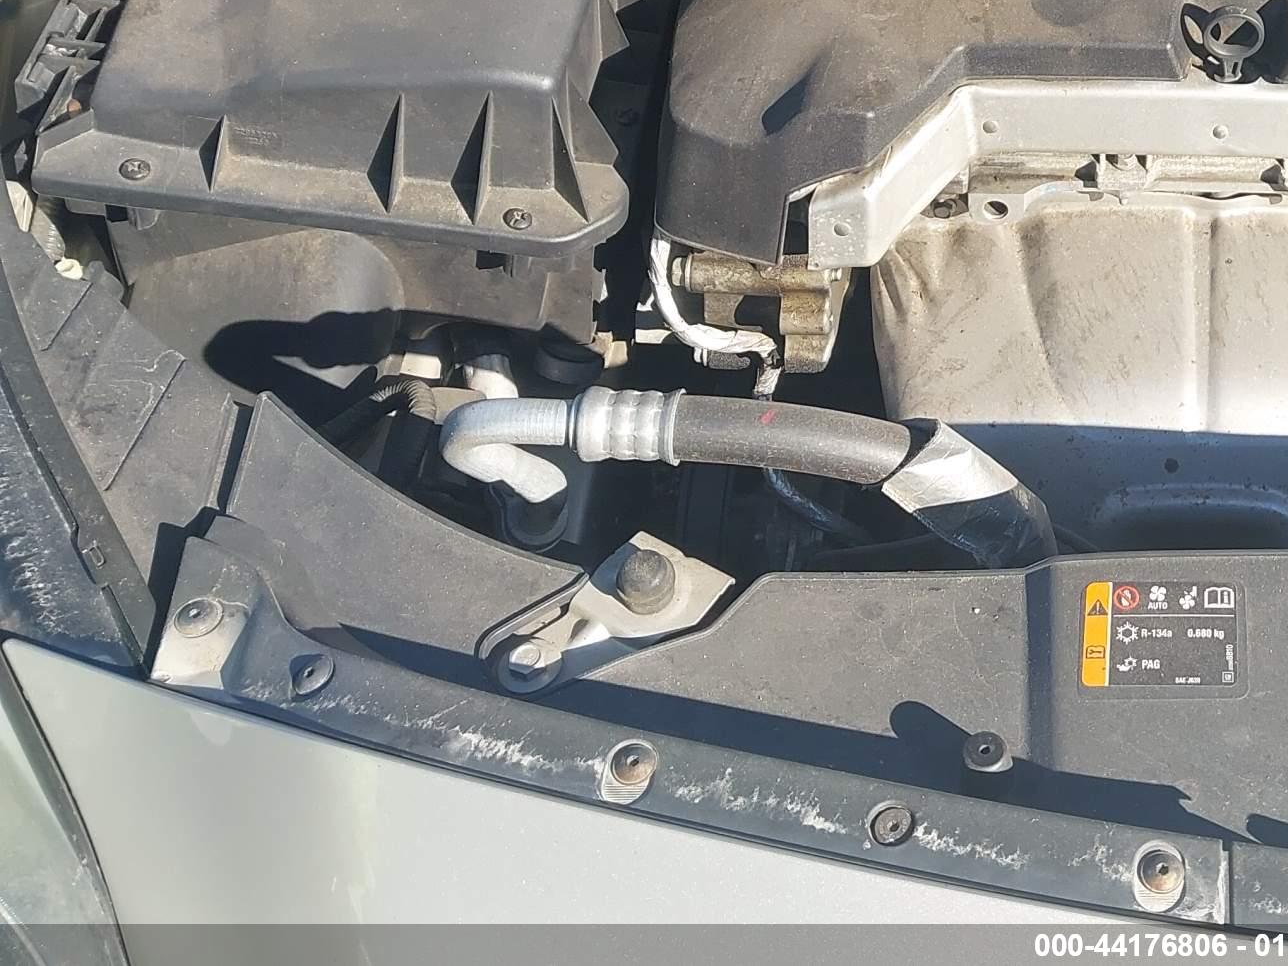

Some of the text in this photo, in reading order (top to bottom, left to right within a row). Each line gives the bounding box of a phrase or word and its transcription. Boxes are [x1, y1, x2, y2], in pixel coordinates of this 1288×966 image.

[1147, 601, 1168, 610] AUTO
[1141, 628, 1173, 638] R-134a
[1213, 628, 1225, 640] kg
[1141, 659, 1161, 670] PAG
